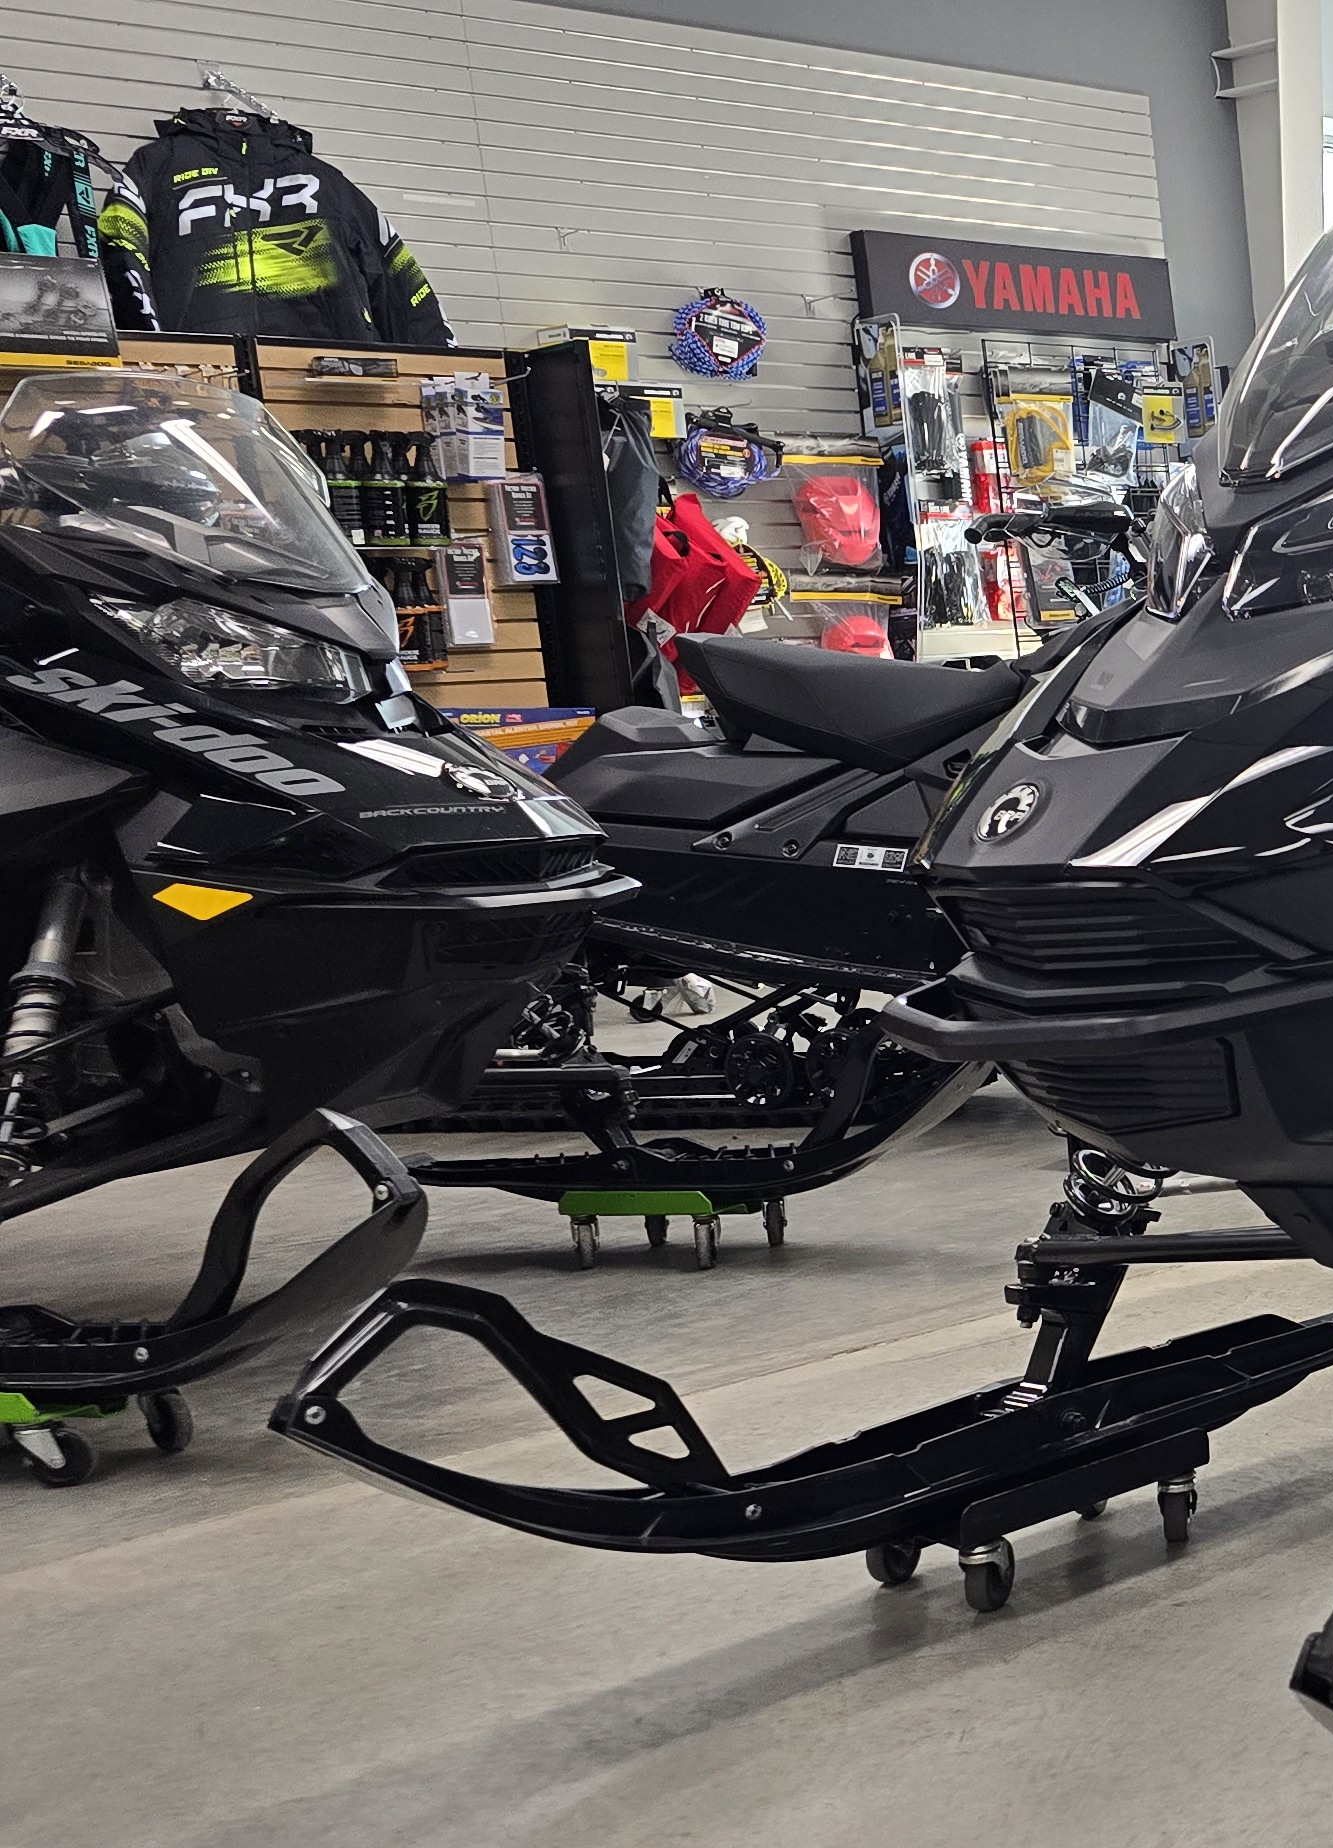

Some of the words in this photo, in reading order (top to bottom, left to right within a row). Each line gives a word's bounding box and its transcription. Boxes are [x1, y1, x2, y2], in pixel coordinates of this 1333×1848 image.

[1, 126, 39, 138] FXR
[178, 173, 320, 237] FXR
[961, 258, 1142, 320] YAMAHA
[359, 805, 505, 819] BACKCOUNTRY
